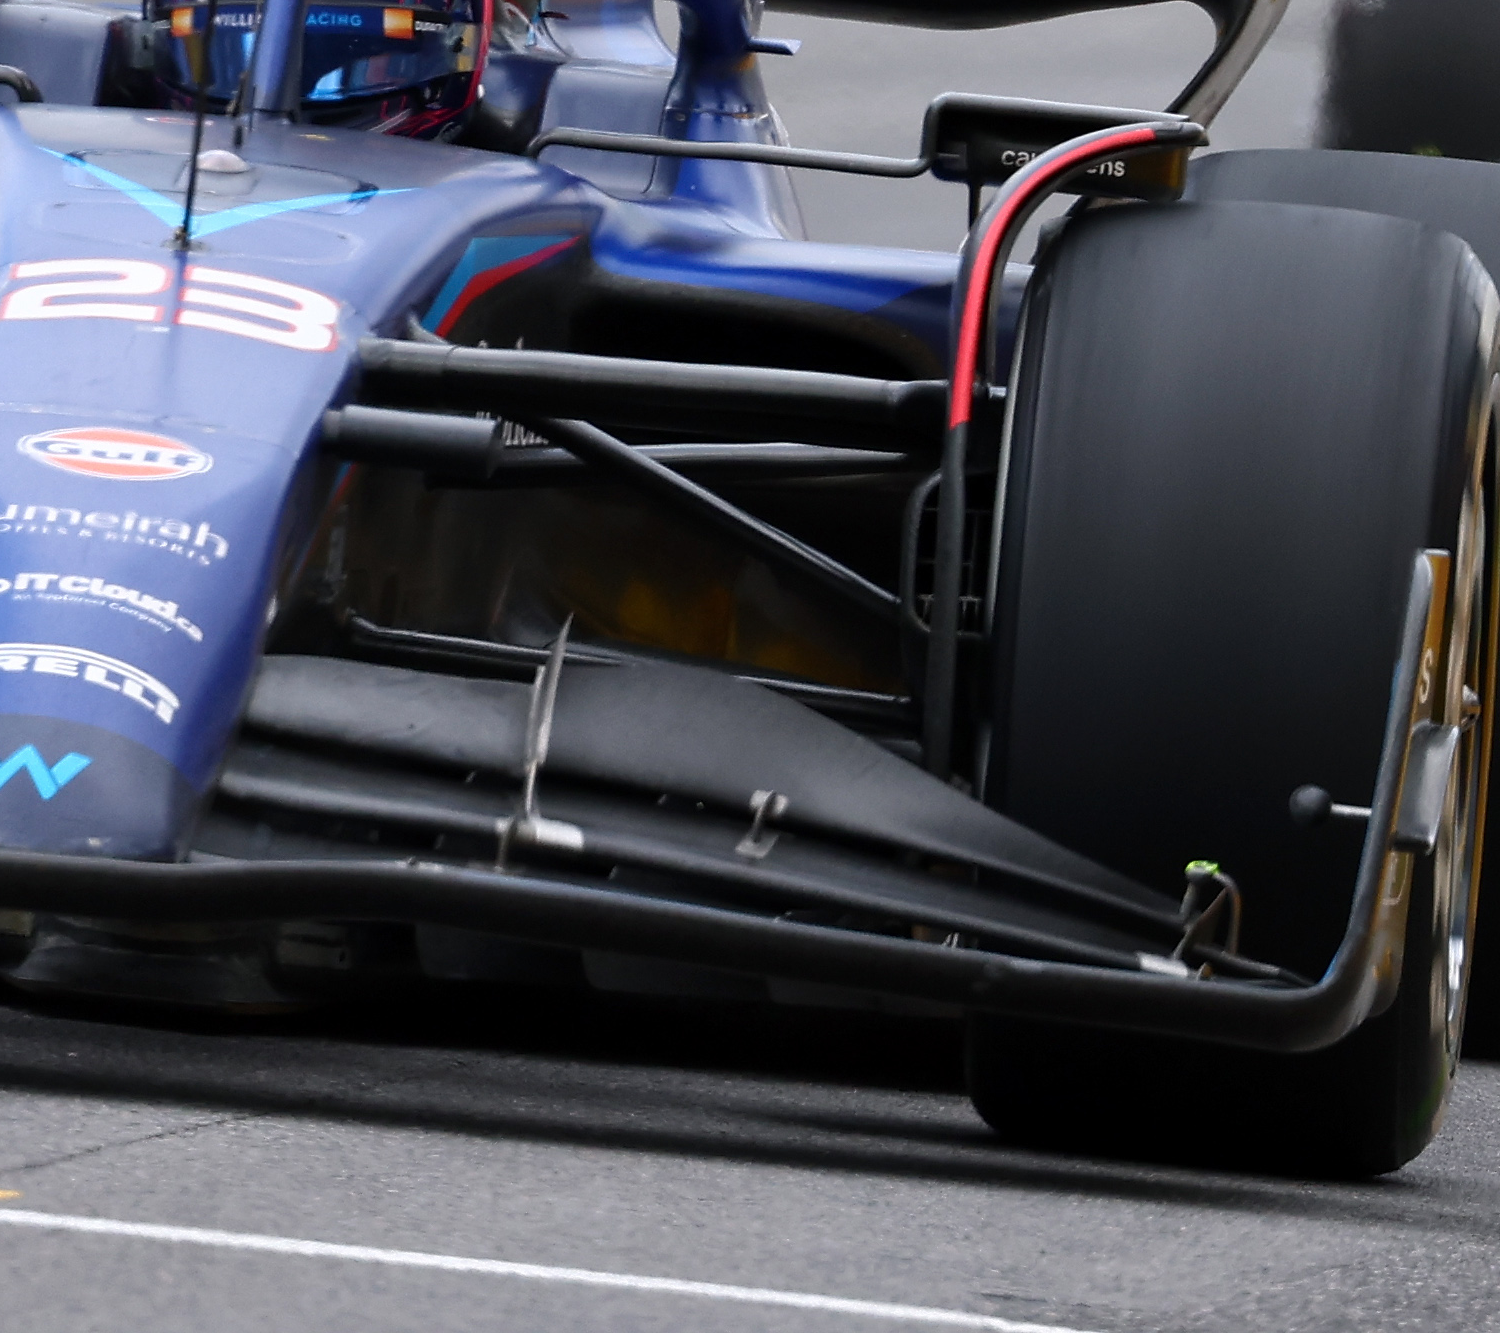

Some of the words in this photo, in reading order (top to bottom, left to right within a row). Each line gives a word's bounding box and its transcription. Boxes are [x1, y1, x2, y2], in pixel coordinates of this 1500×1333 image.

[305, 12, 363, 27] ACING
[0, 258, 341, 352] 23
[31, 439, 199, 468] Gulf
